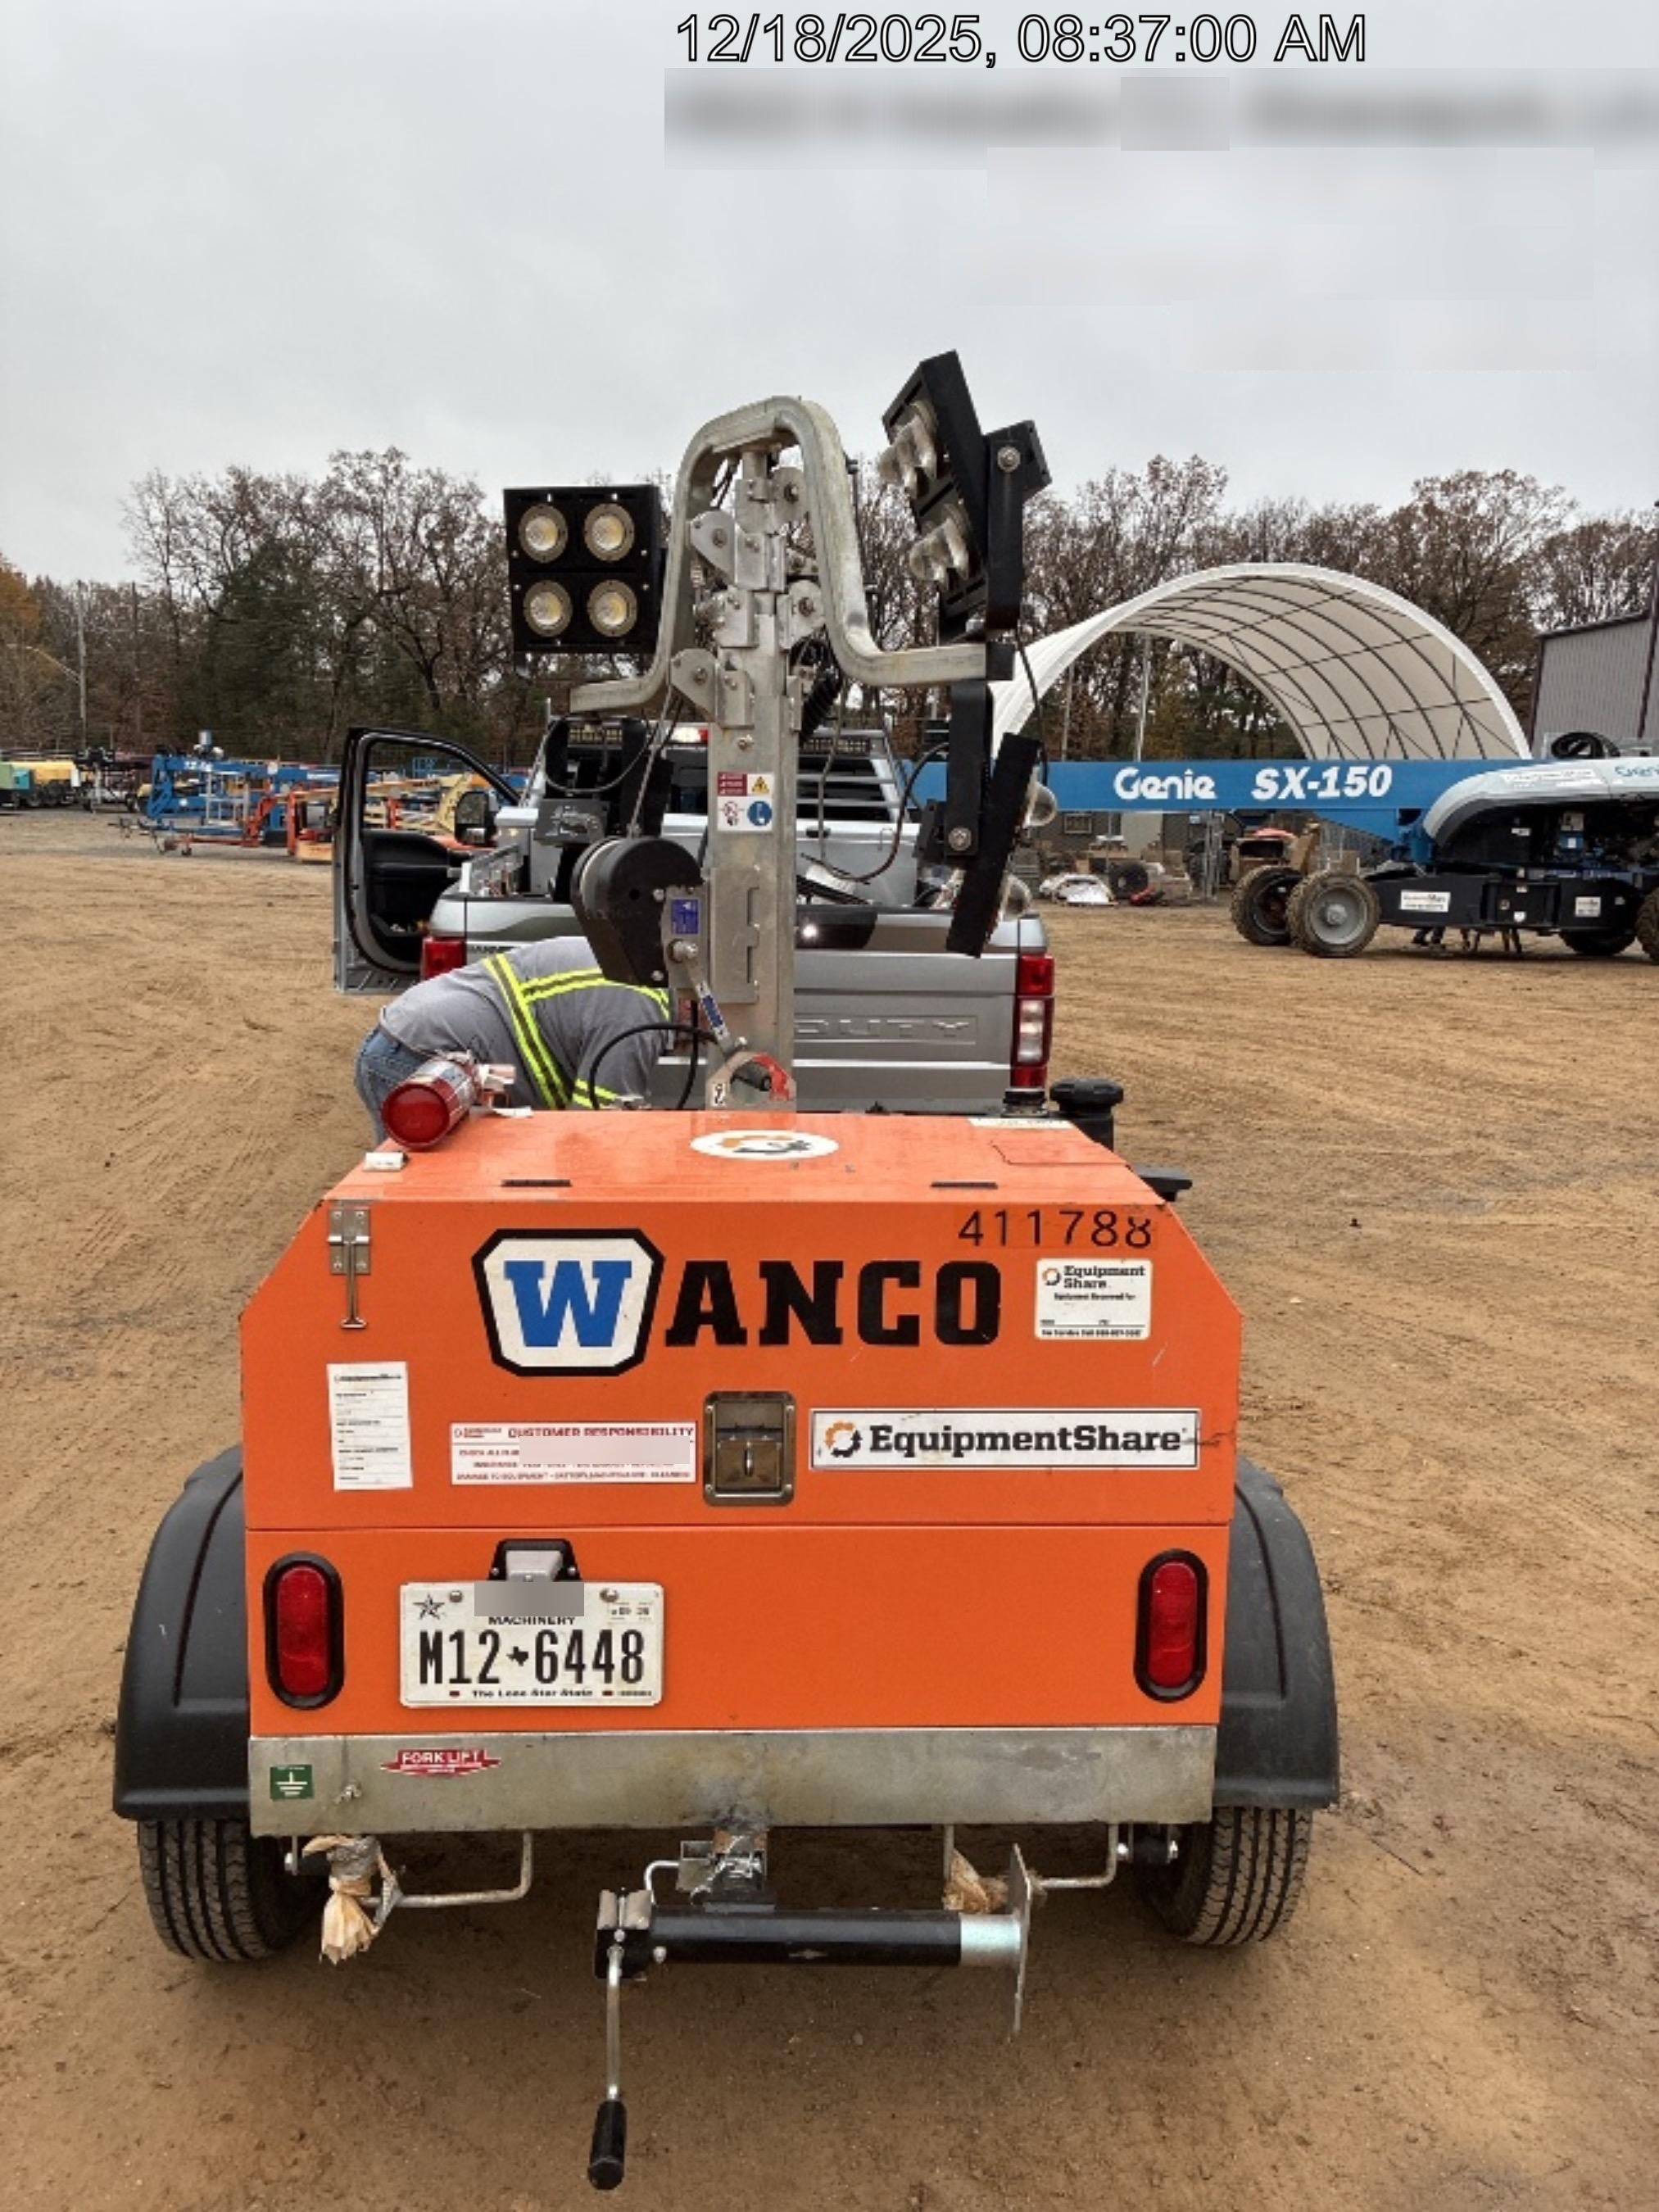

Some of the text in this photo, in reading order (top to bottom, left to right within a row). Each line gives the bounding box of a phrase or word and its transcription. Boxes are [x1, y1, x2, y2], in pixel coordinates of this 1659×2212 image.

[1114, 764, 1393, 800] Genie SX-150
[959, 1209, 1151, 1248] 411788
[1063, 1265, 1145, 1278] Equipment
[1063, 1278, 1107, 1289] Share
[503, 1260, 1001, 1348] WANCO
[508, 1427, 580, 1439] CUSTOMER
[583, 1427, 694, 1436] RESPONSIBILITY
[869, 1426, 1181, 1457] EquipmentShare
[488, 1616, 575, 1625] MACHINERY
[419, 1629, 645, 1684] M12 6448
